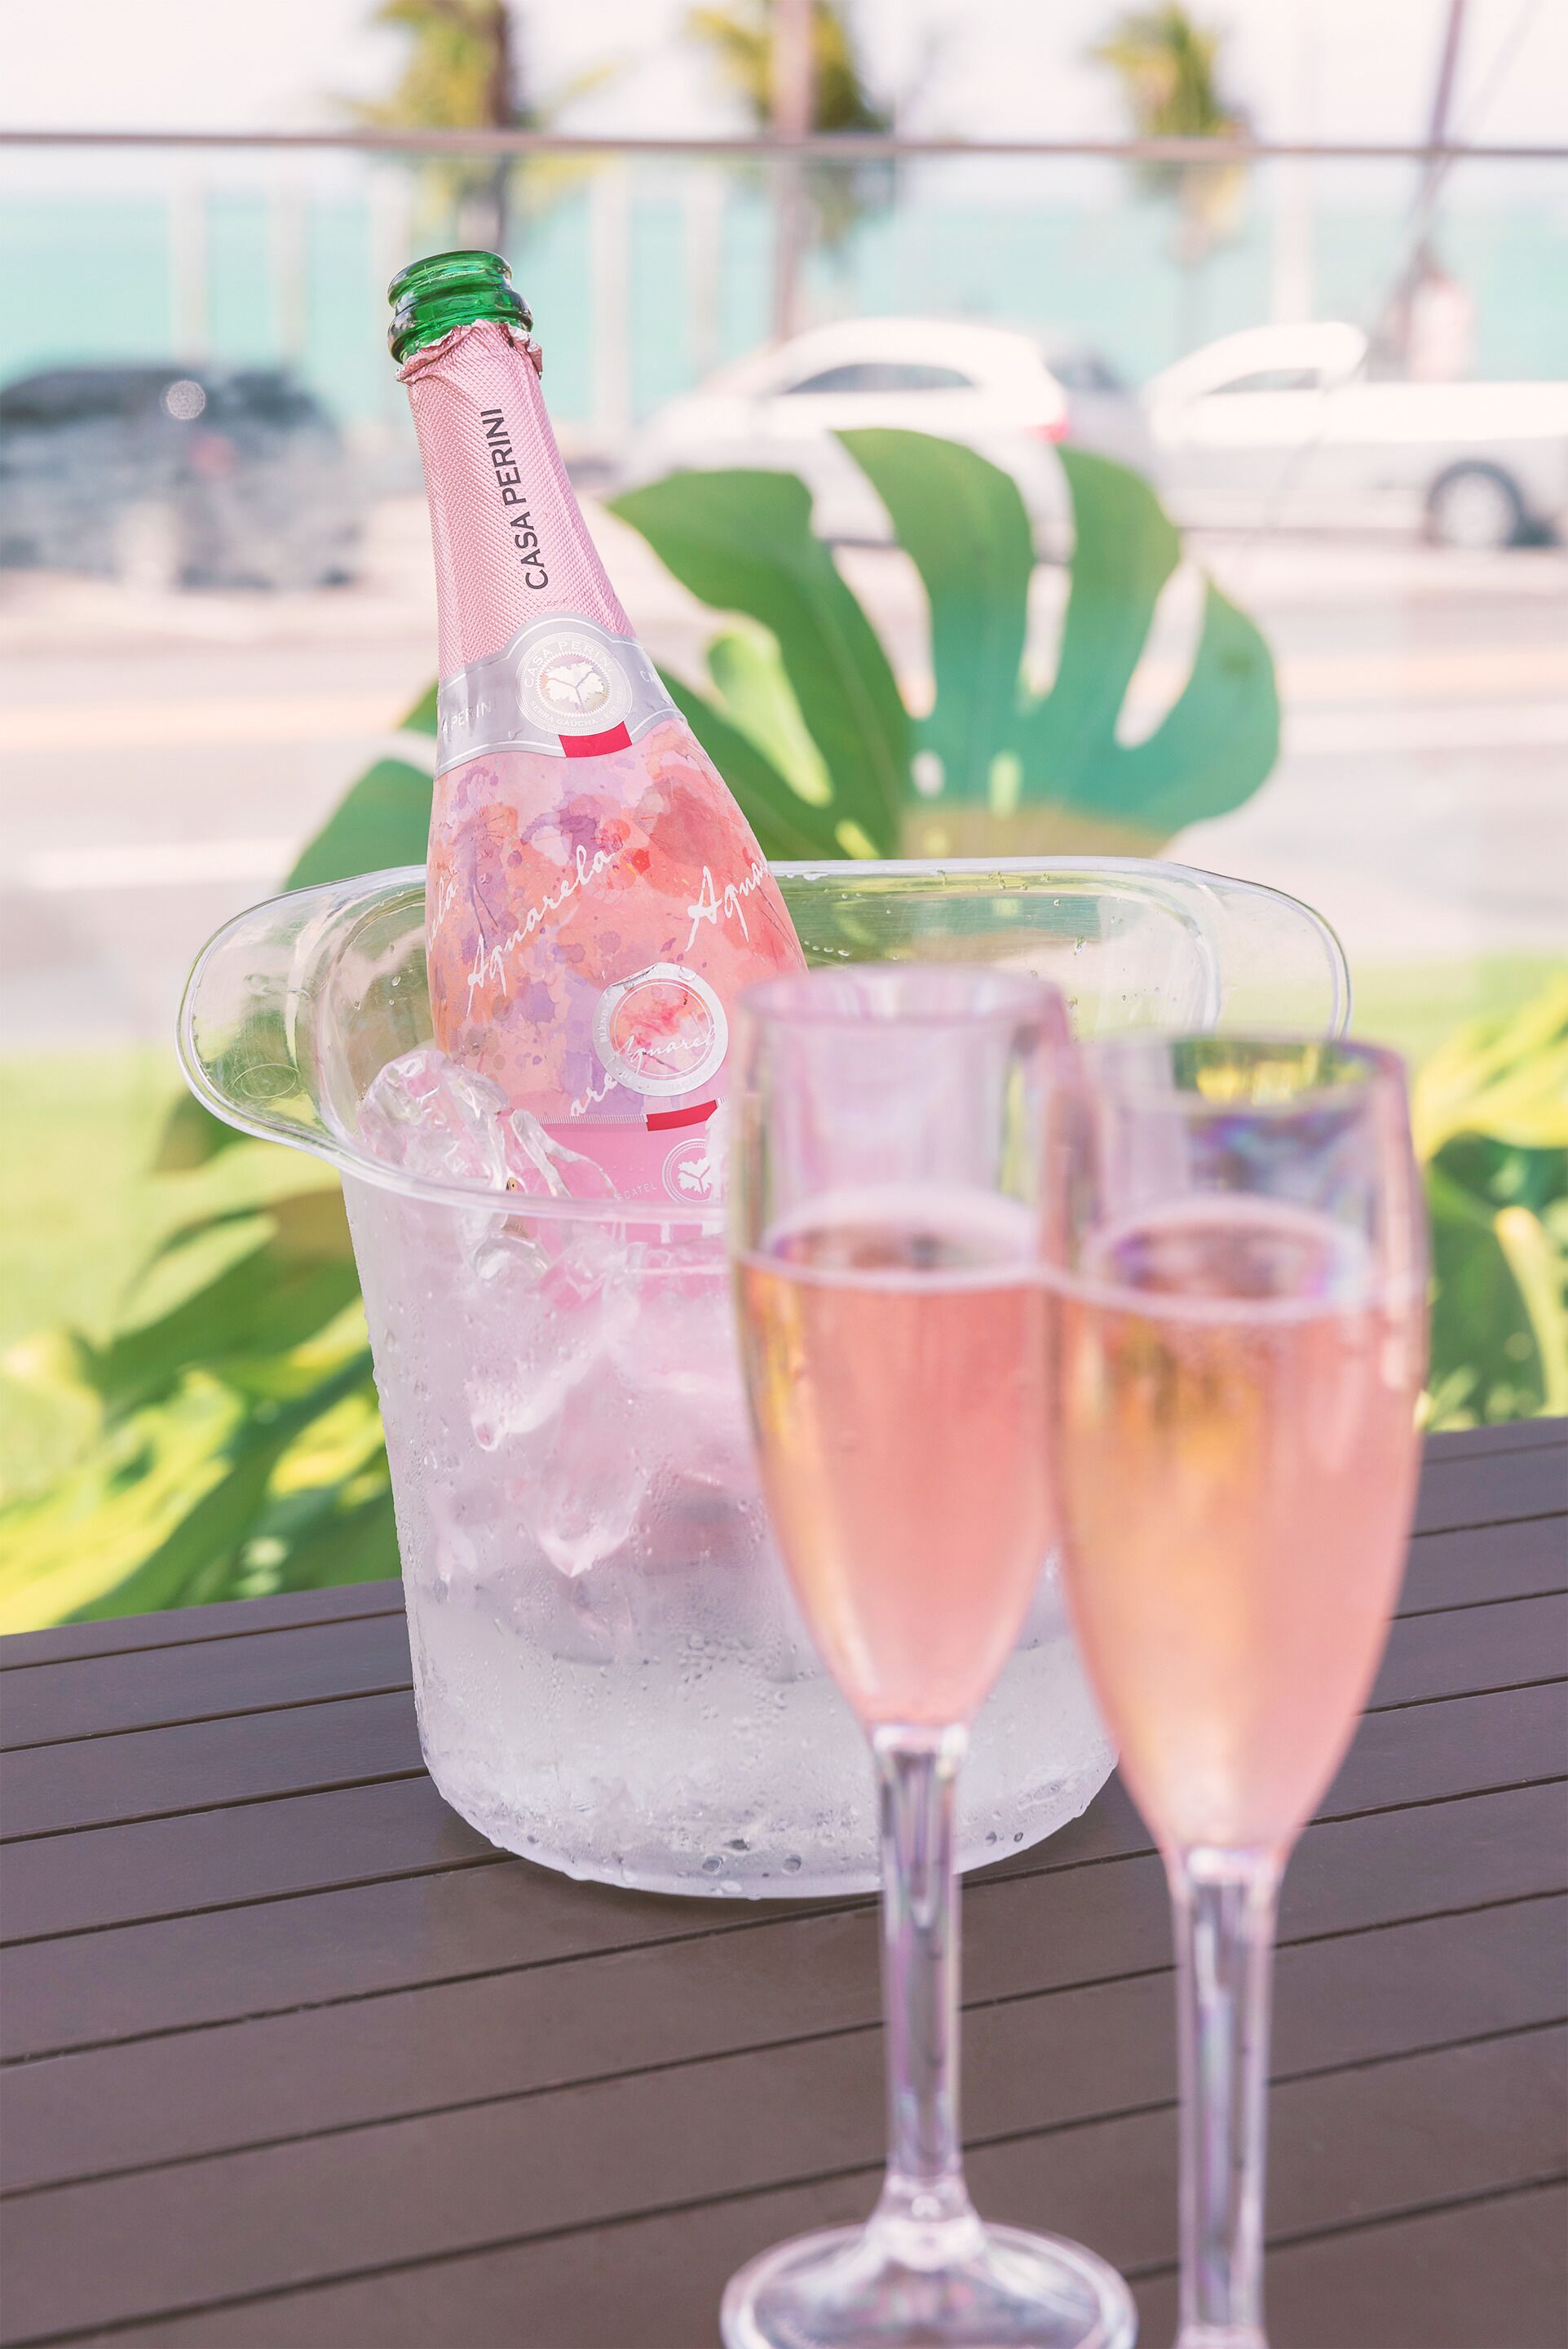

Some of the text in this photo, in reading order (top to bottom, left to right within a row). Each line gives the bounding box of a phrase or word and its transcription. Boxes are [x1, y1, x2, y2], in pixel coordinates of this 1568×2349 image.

[480, 409, 549, 590] CASA PERINI
[523, 648, 554, 688] CASA
[451, 698, 496, 731] PERIN
[529, 700, 554, 723] SERRA
[466, 844, 621, 1017] Aquarela
[685, 862, 764, 952] Aqua
[605, 1022, 718, 1077] Aquarel
